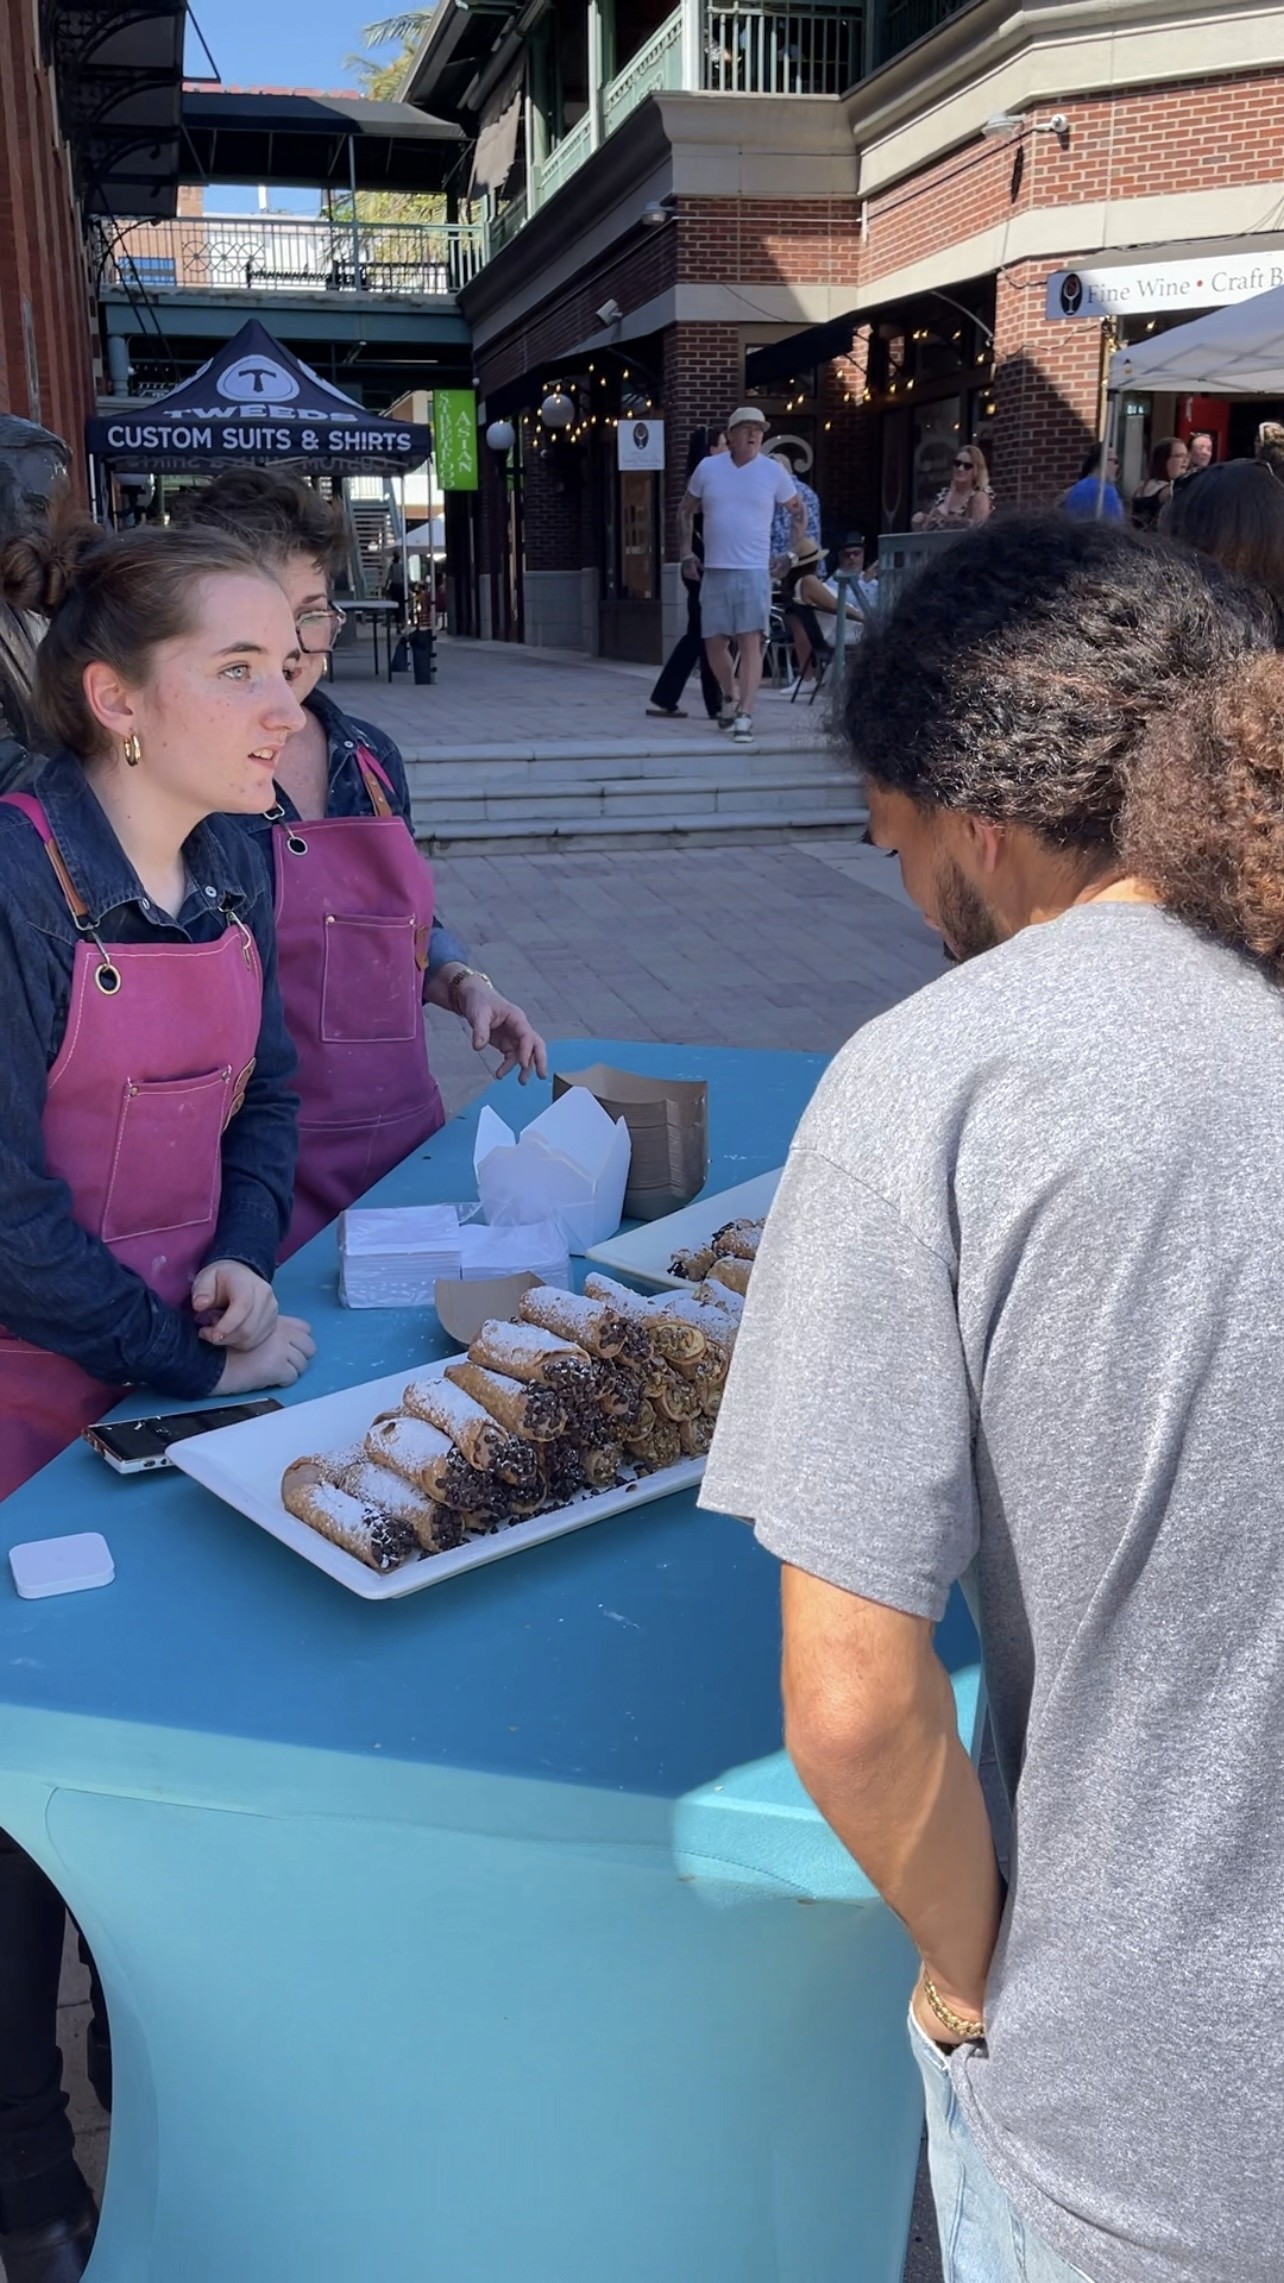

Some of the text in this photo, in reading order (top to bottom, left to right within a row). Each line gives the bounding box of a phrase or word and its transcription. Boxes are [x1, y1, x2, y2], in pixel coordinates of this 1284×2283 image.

[1087, 284, 1130, 303] Fine
[1137, 278, 1190, 298] Wine
[1211, 267, 1264, 292] Craft
[238, 368, 277, 392] T
[162, 403, 359, 422] TWEEDS
[107, 425, 411, 452] CUSTOM SUITS & SHIRTS
[455, 410, 472, 473] ASIAN
